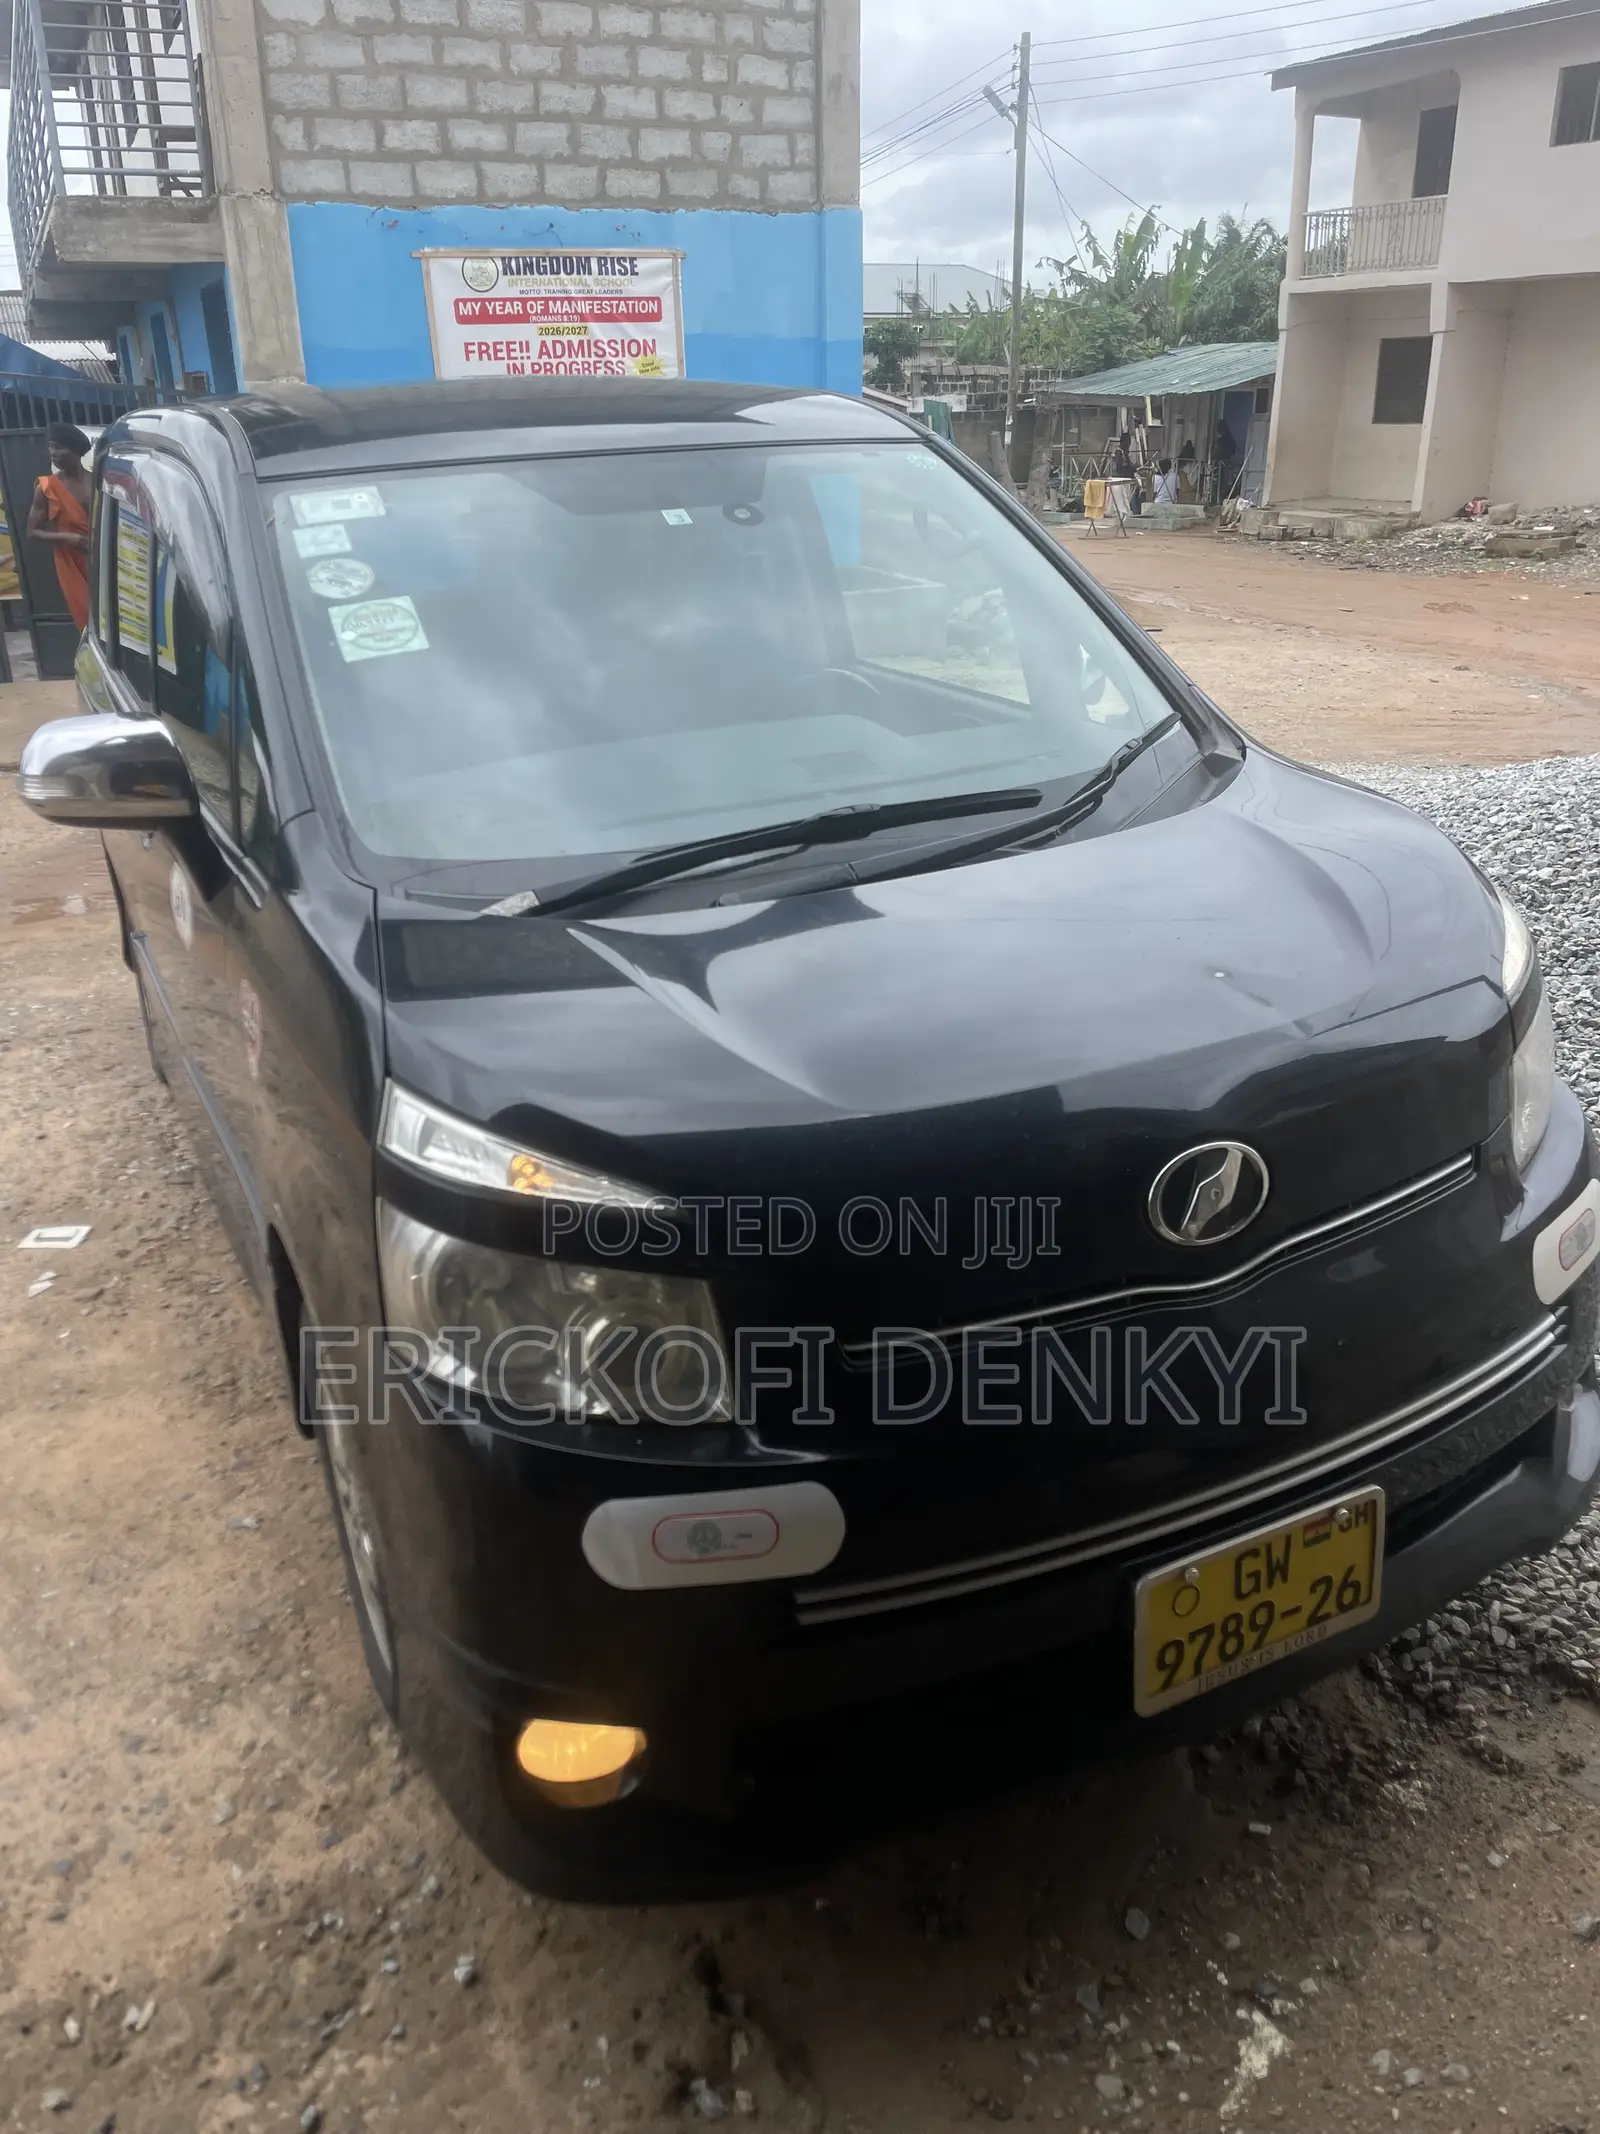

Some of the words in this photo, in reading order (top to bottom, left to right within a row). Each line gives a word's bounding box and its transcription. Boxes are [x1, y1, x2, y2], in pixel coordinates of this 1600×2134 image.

[501, 256, 592, 276] KINGDOM
[597, 256, 639, 276] RISE
[508, 277, 590, 288] INTERNATIONAL
[593, 277, 636, 287] SCHOOL
[458, 301, 481, 315] MY
[485, 301, 523, 315] YEAR
[526, 301, 545, 314] OF
[549, 300, 658, 314] MANIFESTATION
[529, 315, 562, 324] (ROMANS
[538, 326, 589, 337] 2026/2027
[464, 340, 531, 362] FREE!!
[537, 338, 657, 360] ADMISSION
[506, 362, 526, 376] IN
[1234, 1533, 1292, 1602] GW
[1156, 1563, 1362, 1692] 9789-26
